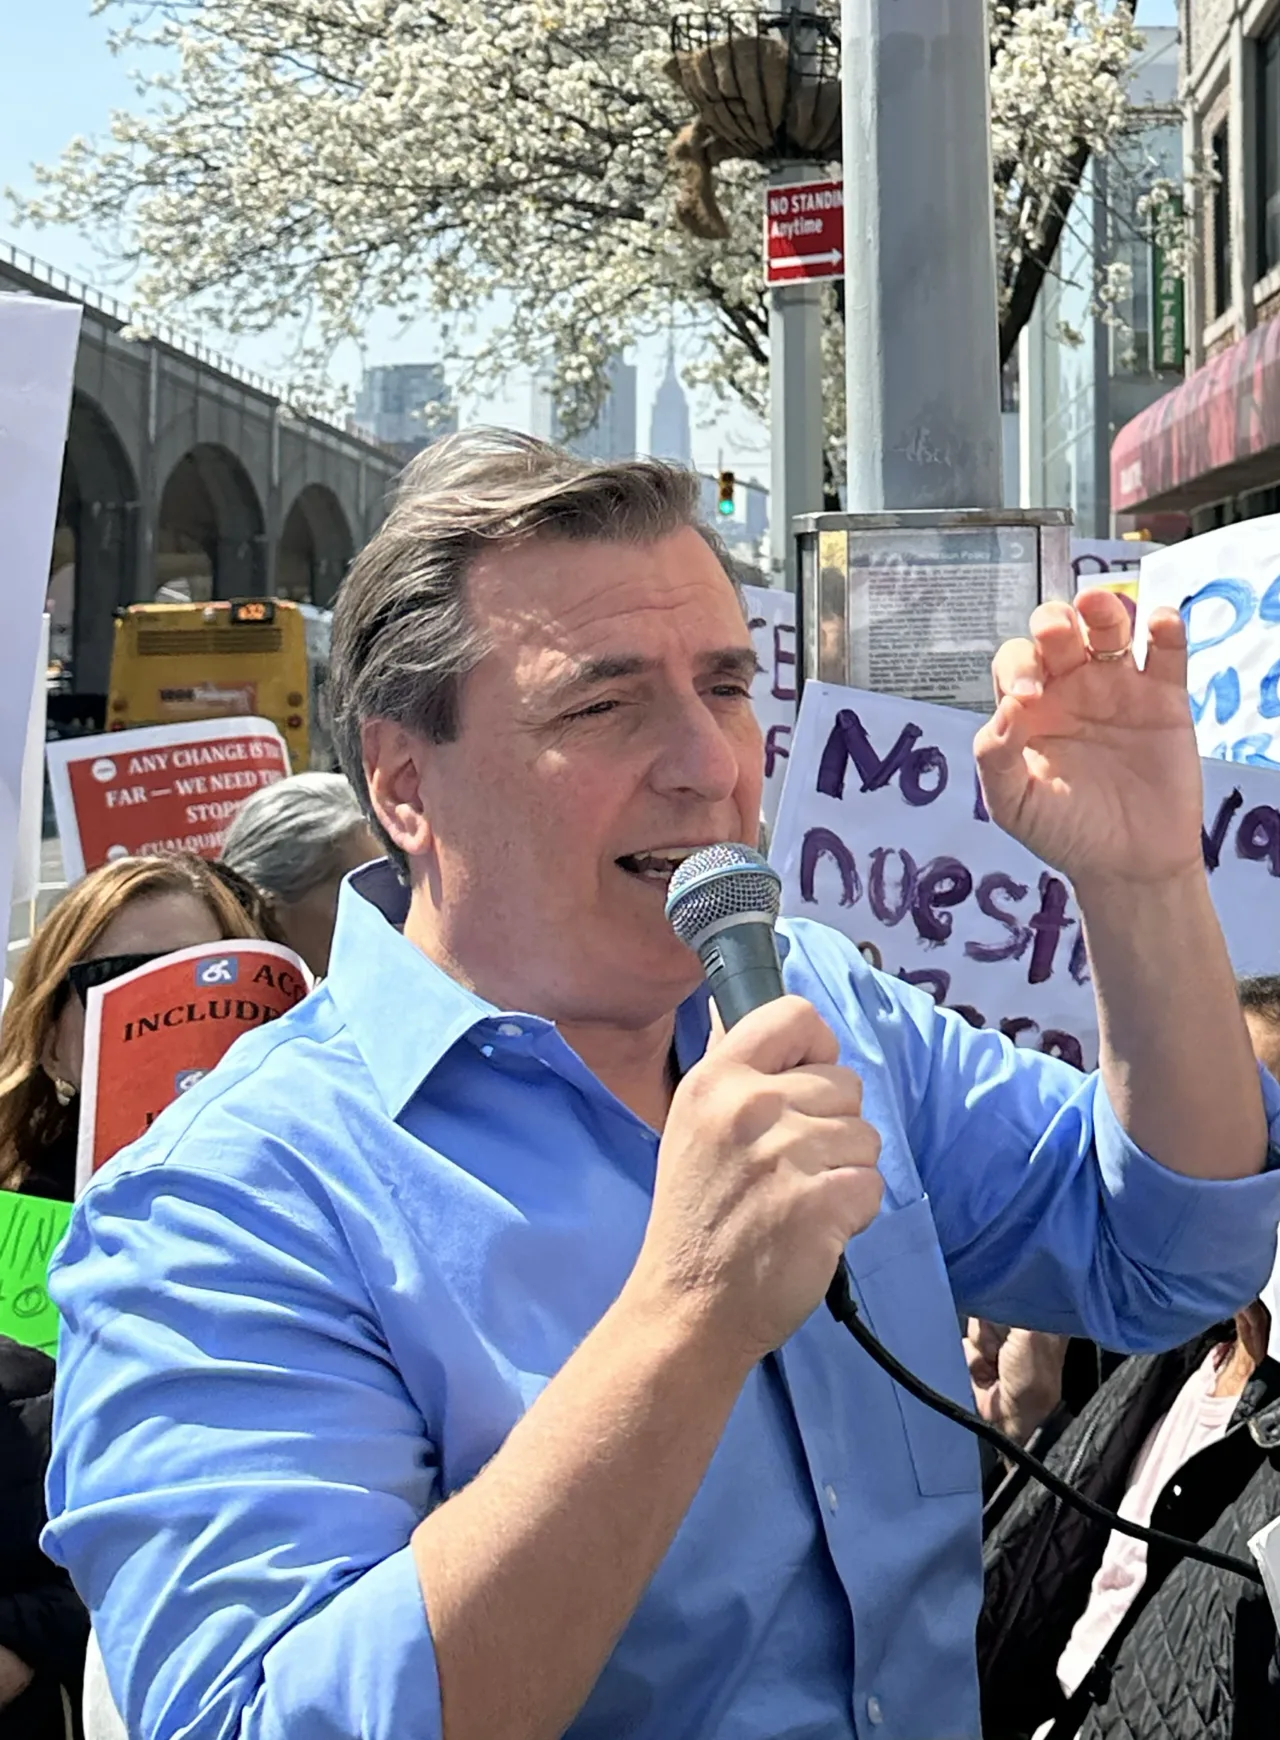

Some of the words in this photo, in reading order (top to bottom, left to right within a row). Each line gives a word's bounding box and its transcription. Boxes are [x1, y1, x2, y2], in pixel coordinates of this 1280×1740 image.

[770, 197, 789, 215] NO
[791, 190, 844, 213] STANDIN
[771, 218, 823, 240] Anytime
[1160, 300, 1176, 364] TREE
[128, 753, 169, 776] ANY
[172, 743, 249, 768] CHANGE
[250, 741, 263, 759] IS
[816, 708, 949, 807] No
[105, 786, 148, 809] FAR
[175, 775, 208, 797] WE
[210, 770, 258, 792] NEED
[800, 826, 1092, 986] nuest
